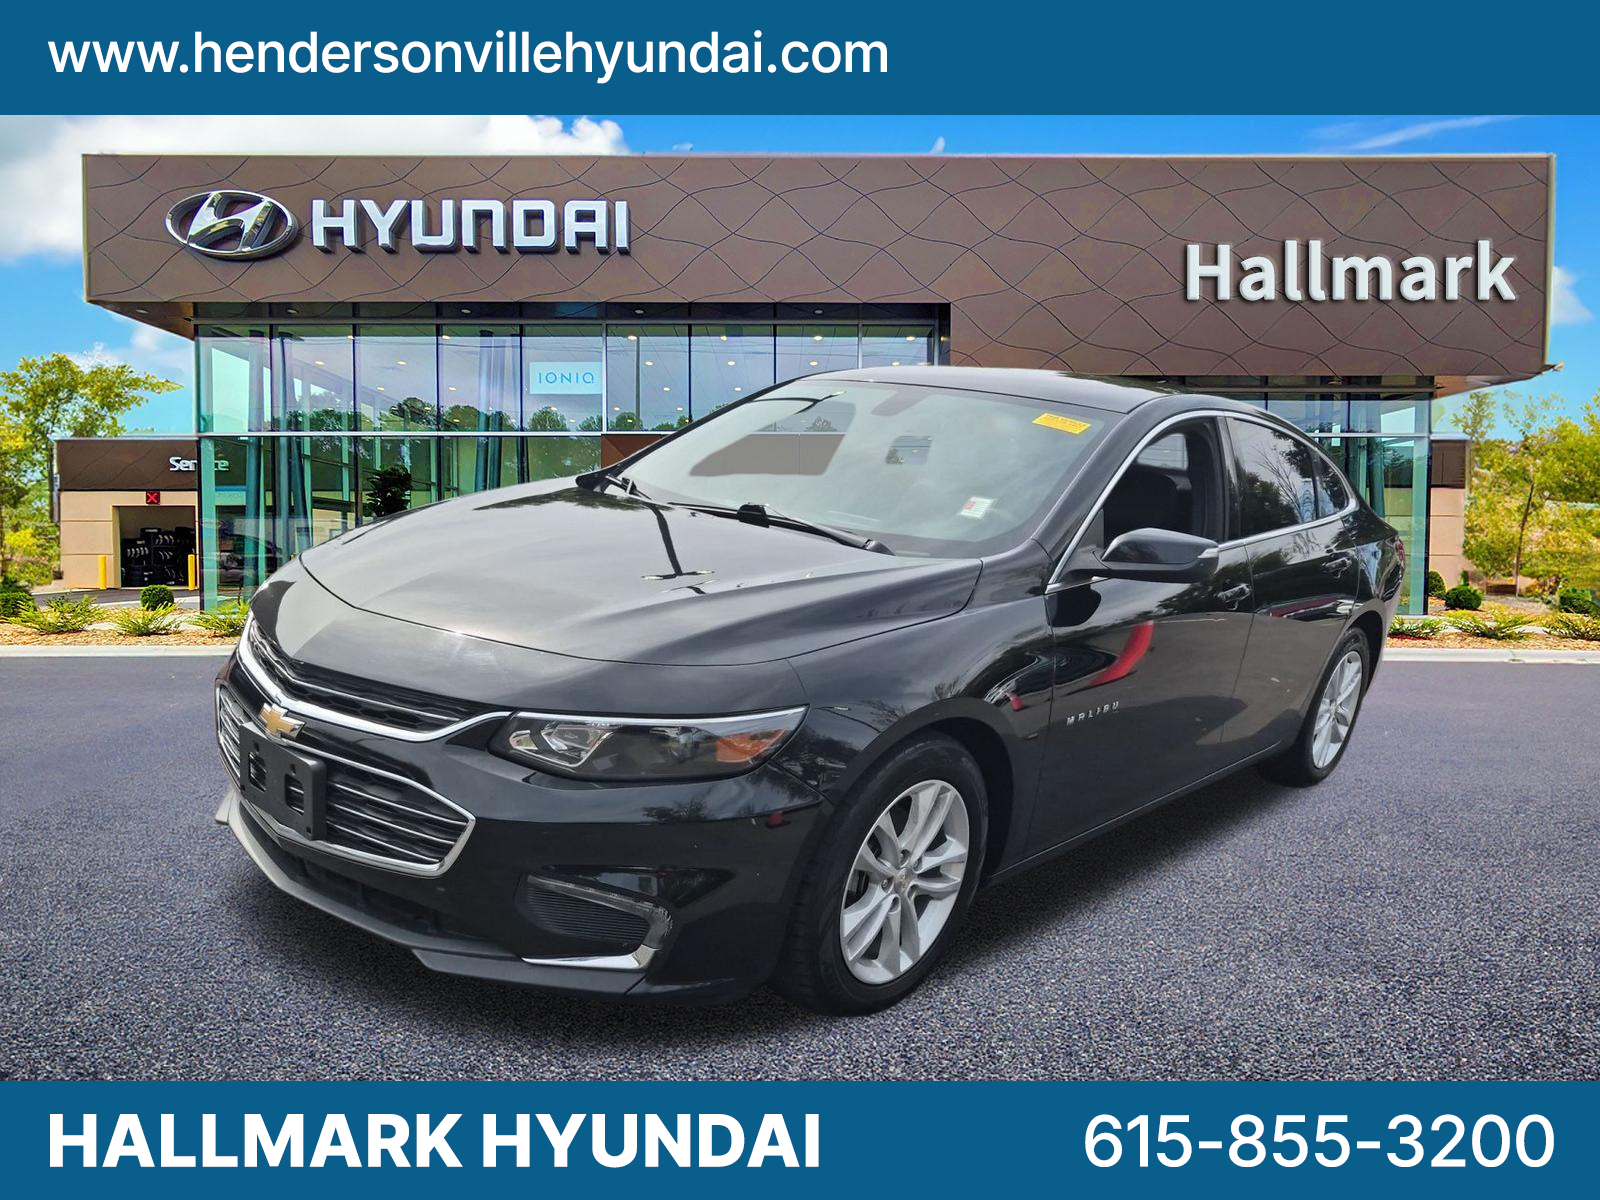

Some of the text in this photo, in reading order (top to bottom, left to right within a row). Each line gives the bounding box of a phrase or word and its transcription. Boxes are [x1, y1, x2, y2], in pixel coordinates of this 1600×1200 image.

[312, 199, 630, 252] HYUNDAI
[1186, 239, 1516, 301] Hallmark
[538, 371, 594, 384] IONIQ
[1066, 700, 1119, 726] MALIBU
